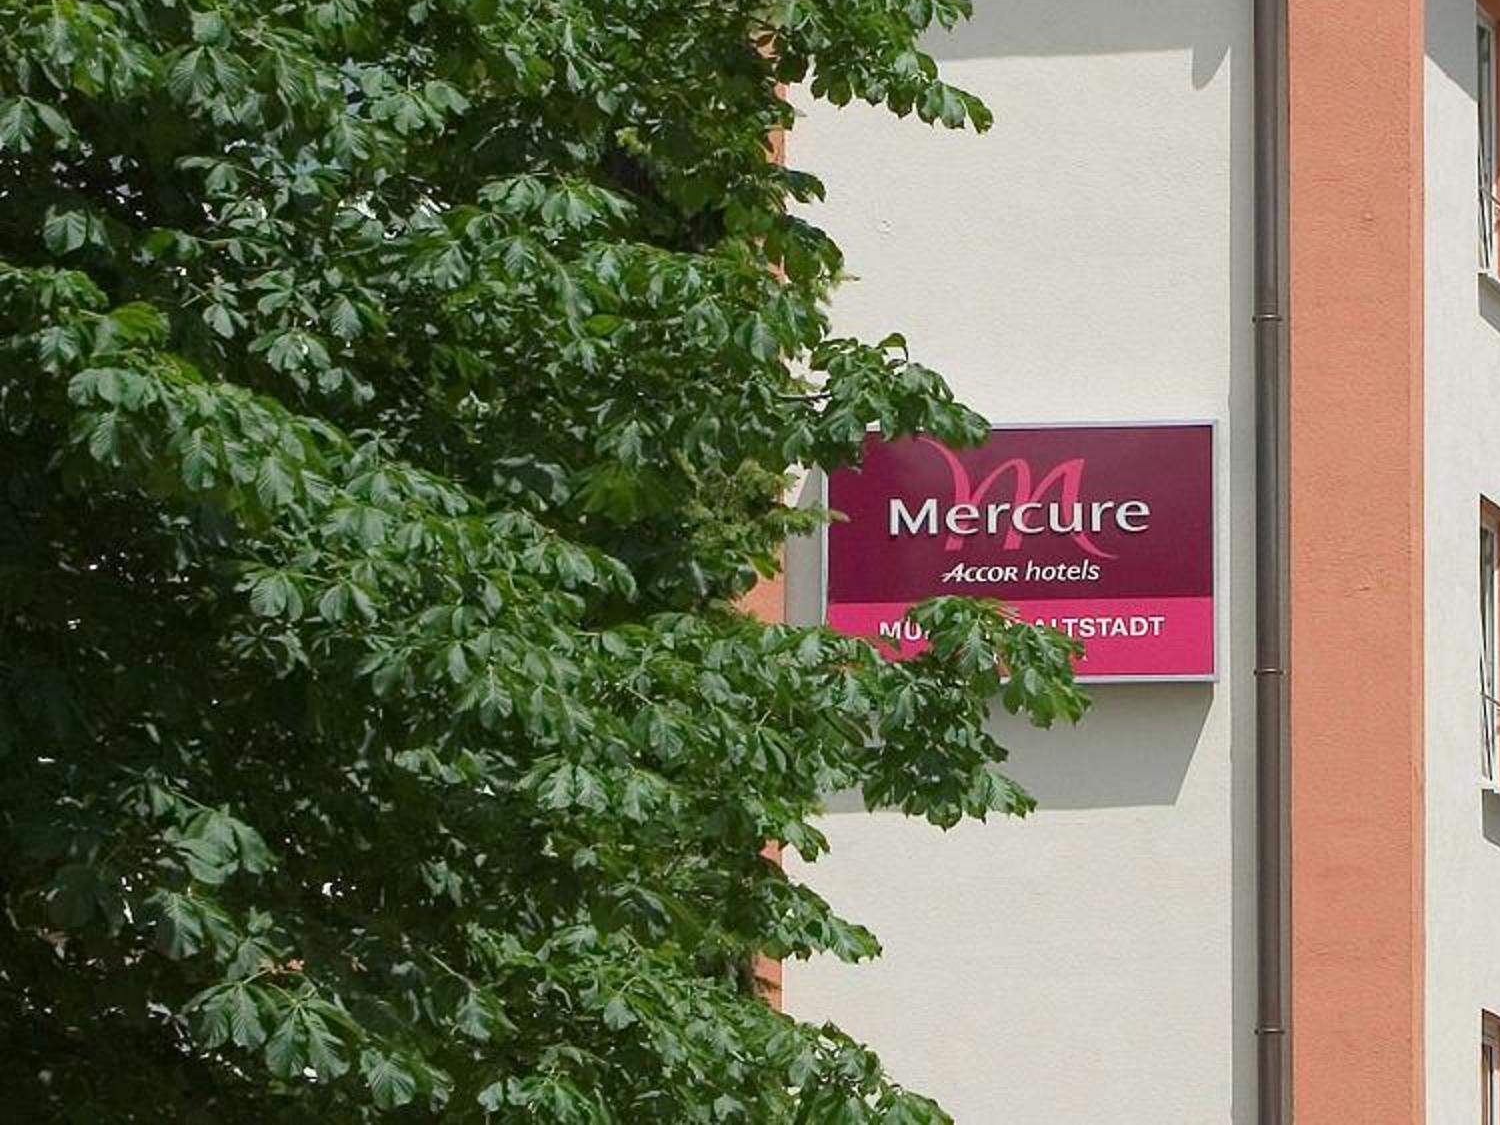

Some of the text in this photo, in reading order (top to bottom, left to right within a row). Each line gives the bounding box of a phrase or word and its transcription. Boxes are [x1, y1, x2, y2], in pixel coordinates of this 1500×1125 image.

[889, 497, 1151, 536] Mercure
[1025, 559, 1101, 582] hotels
[1033, 616, 1165, 638] TSTADT
